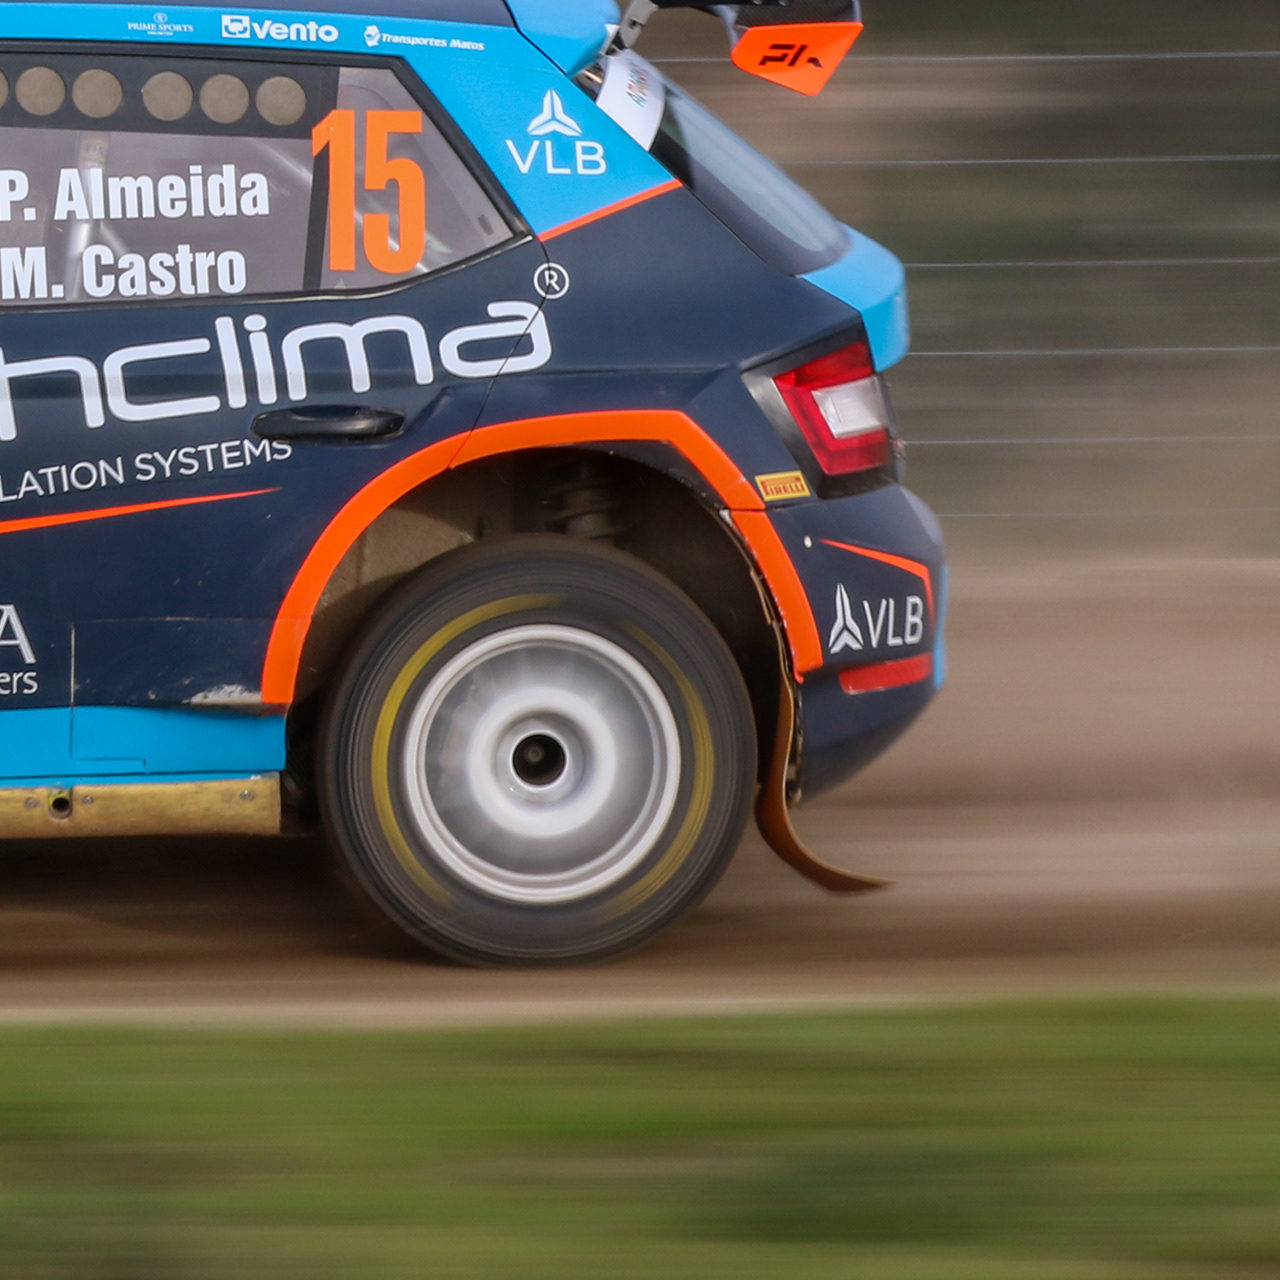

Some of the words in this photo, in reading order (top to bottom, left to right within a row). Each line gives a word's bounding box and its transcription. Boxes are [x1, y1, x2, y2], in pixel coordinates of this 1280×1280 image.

[127, 22, 157, 31] PRIME
[158, 23, 194, 32] SPORTS
[381, 33, 447, 47] Transportes
[449, 38, 485, 51] Matos
[505, 139, 608, 175] VLB
[54, 164, 270, 221] Almeida
[311, 109, 426, 274] 15
[0, 246, 64, 300] M.
[81, 244, 247, 298] Castro
[135, 438, 293, 483] SYSTEMS
[760, 476, 808, 497] PIRELLI
[862, 595, 925, 649] VLB
